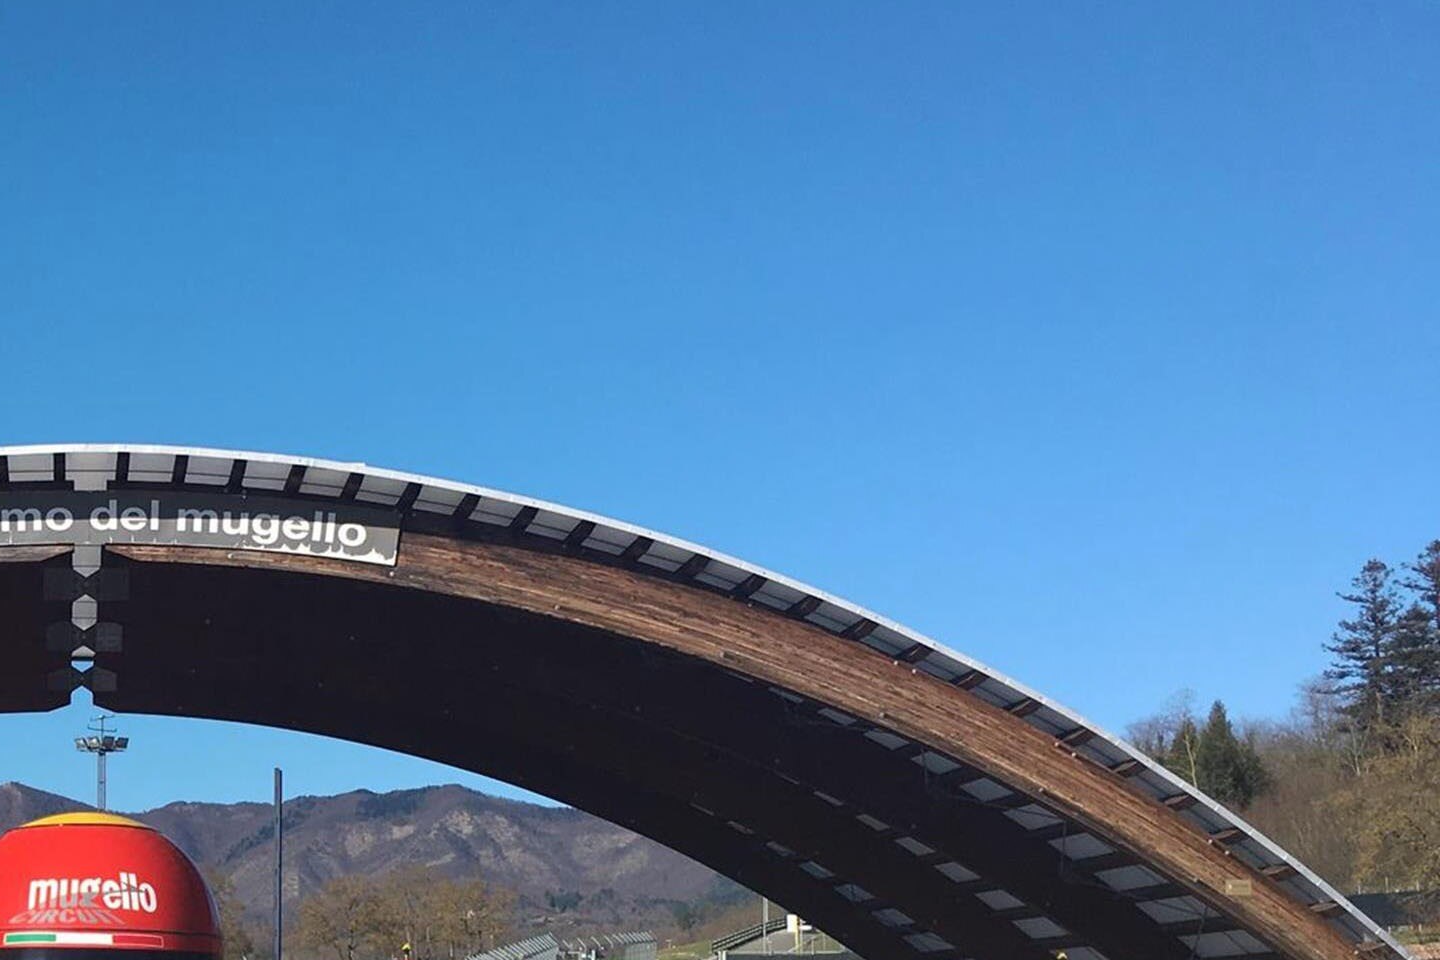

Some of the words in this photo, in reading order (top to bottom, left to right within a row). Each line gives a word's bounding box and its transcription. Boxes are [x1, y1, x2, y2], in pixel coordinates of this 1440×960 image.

[89, 500, 160, 532] del
[176, 507, 367, 547] mugello
[28, 872, 157, 913] mugello
